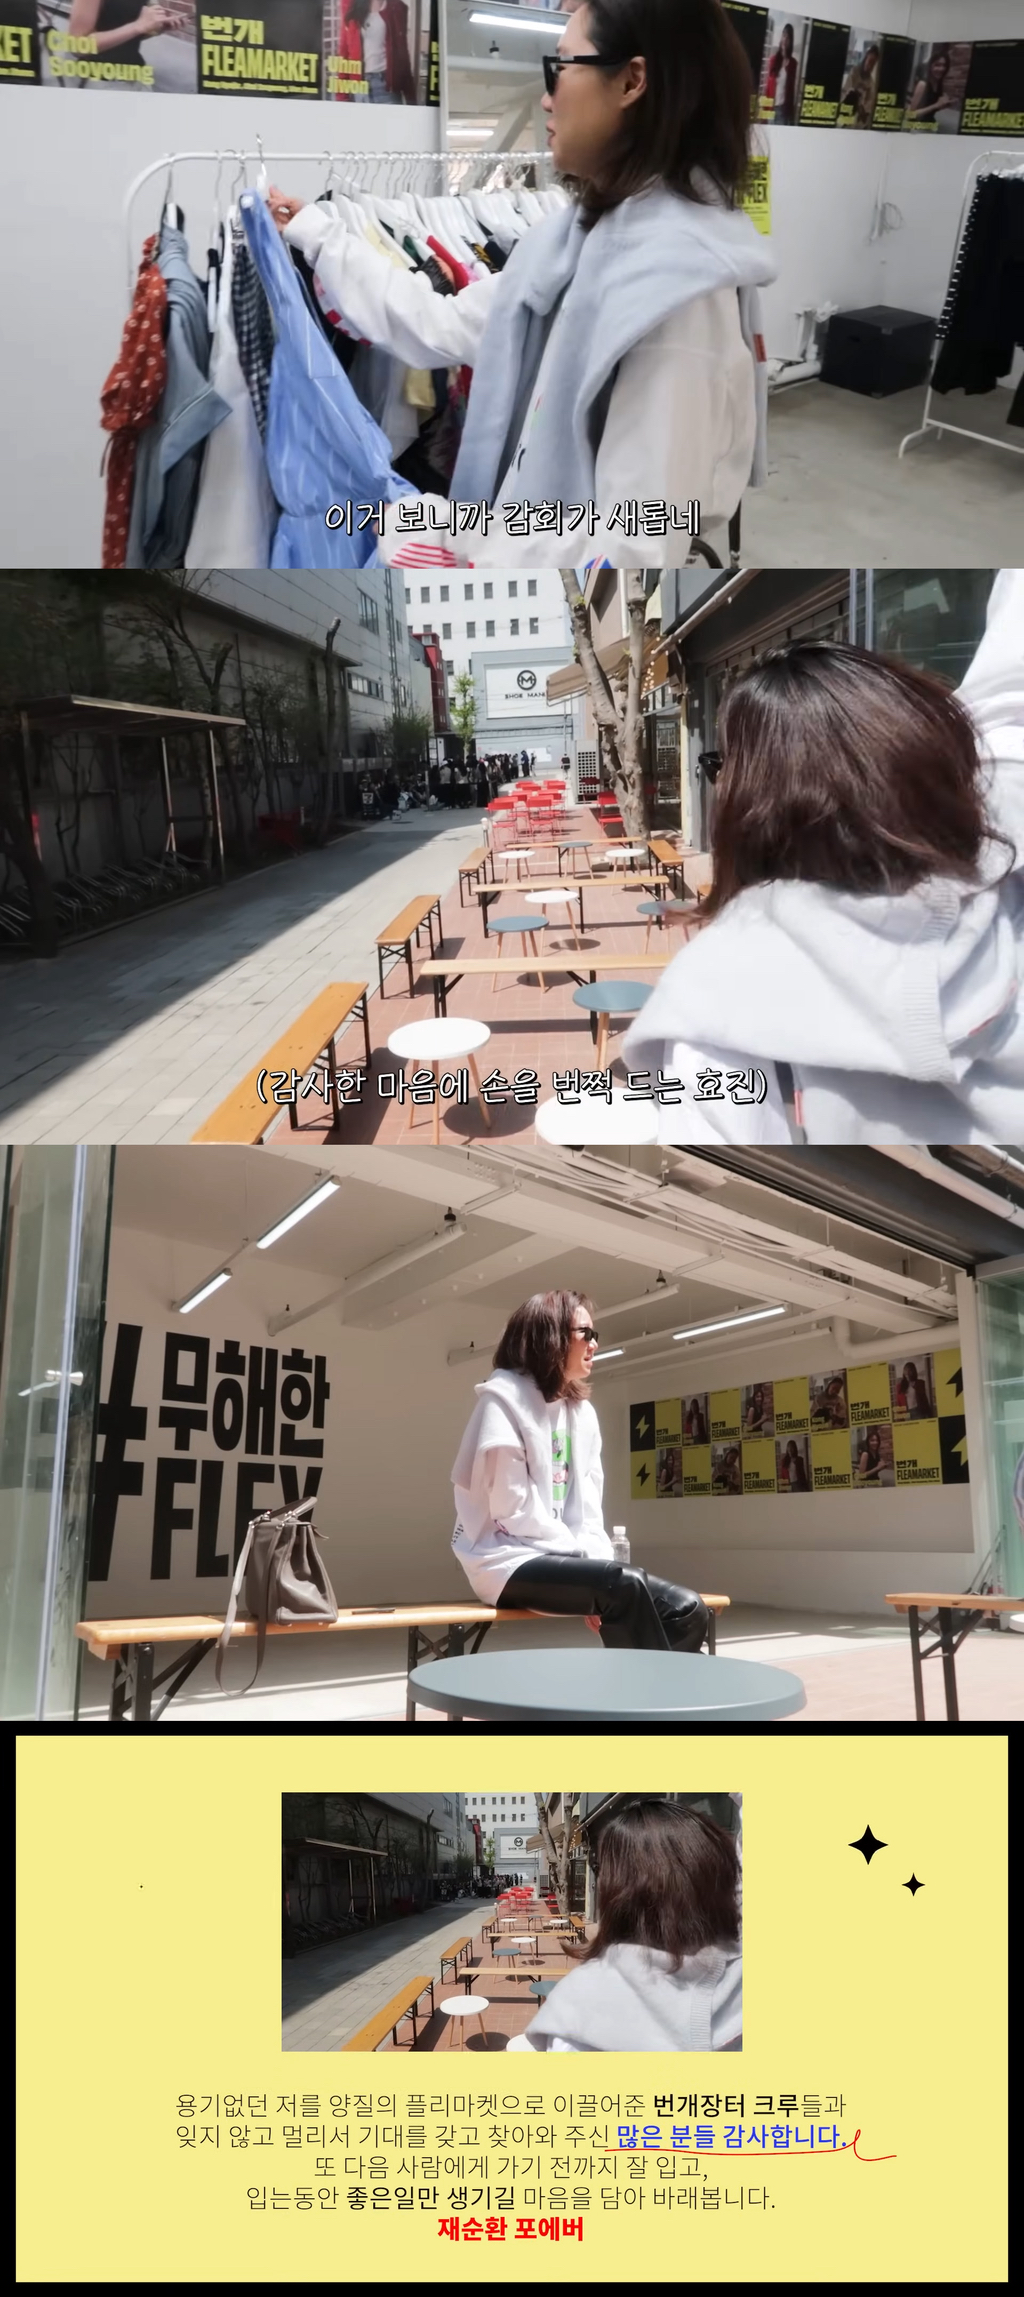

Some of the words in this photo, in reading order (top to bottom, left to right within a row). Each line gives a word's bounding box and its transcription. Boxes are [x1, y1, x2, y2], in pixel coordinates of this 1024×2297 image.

[46, 28, 98, 54] Choi
[201, 14, 264, 45] 번개
[0, 25, 32, 63] ET
[48, 55, 154, 85] Sooyoung
[201, 43, 318, 82] FLEAMARKET
[327, 55, 362, 75] Uhm
[327, 75, 369, 95] Jiwon
[158, 1331, 330, 1459] 무해한
[850, 1407, 890, 1422] FLEAMARKET
[814, 1474, 850, 1486] FLEAMARKET
[896, 1467, 940, 1480] FLEAMARKET
